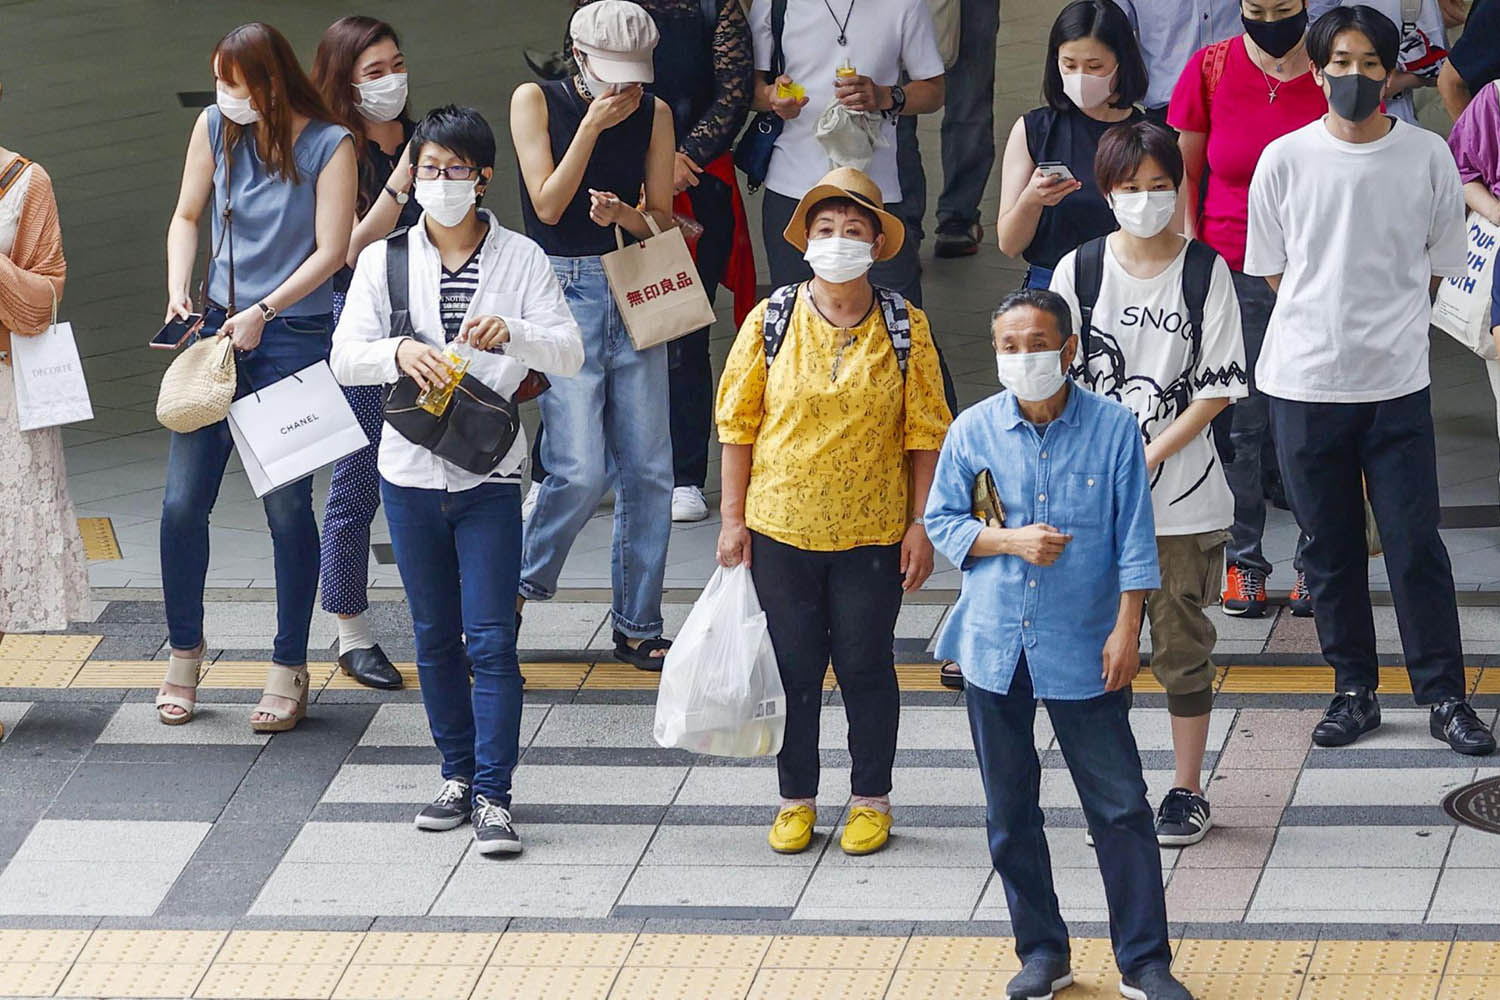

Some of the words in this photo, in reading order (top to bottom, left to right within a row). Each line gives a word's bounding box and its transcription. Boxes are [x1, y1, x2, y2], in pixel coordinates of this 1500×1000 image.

[625, 271, 694, 308] 無印良品
[280, 413, 320, 435] CHANEL
